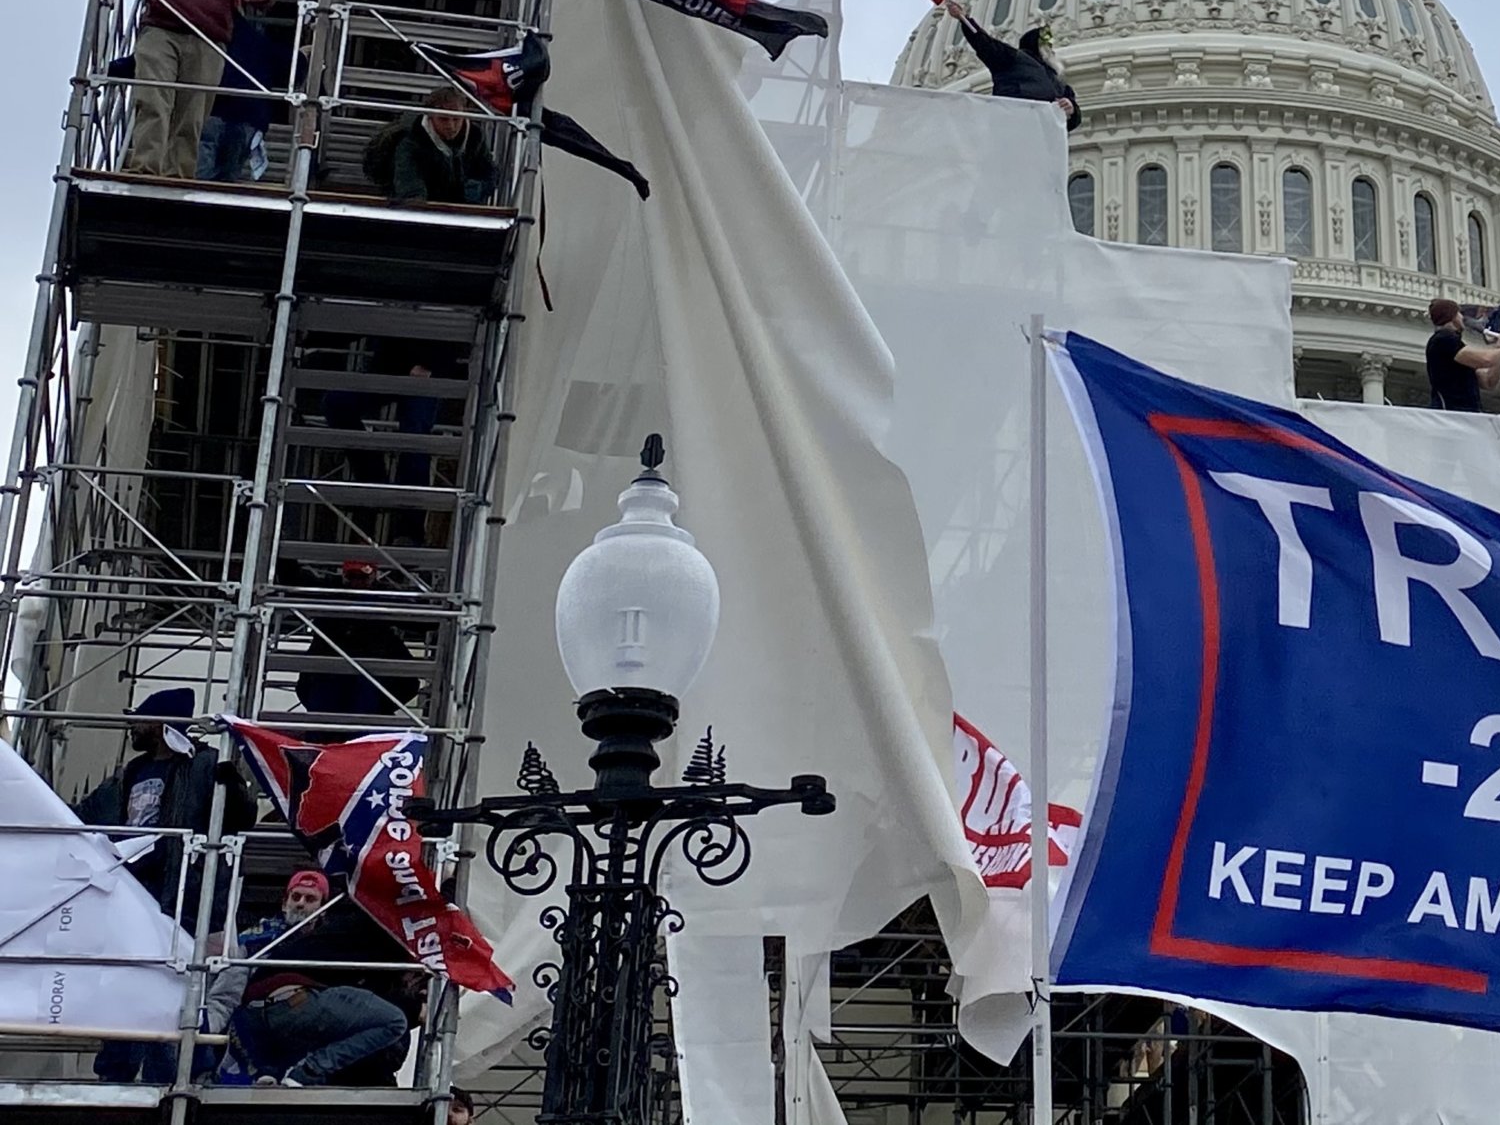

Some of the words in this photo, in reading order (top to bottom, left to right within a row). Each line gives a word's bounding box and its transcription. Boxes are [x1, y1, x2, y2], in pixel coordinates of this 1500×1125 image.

[1207, 841, 1395, 916] KEEP
[48, 971, 66, 1025] HOORAY
[58, 906, 73, 932] FOR
